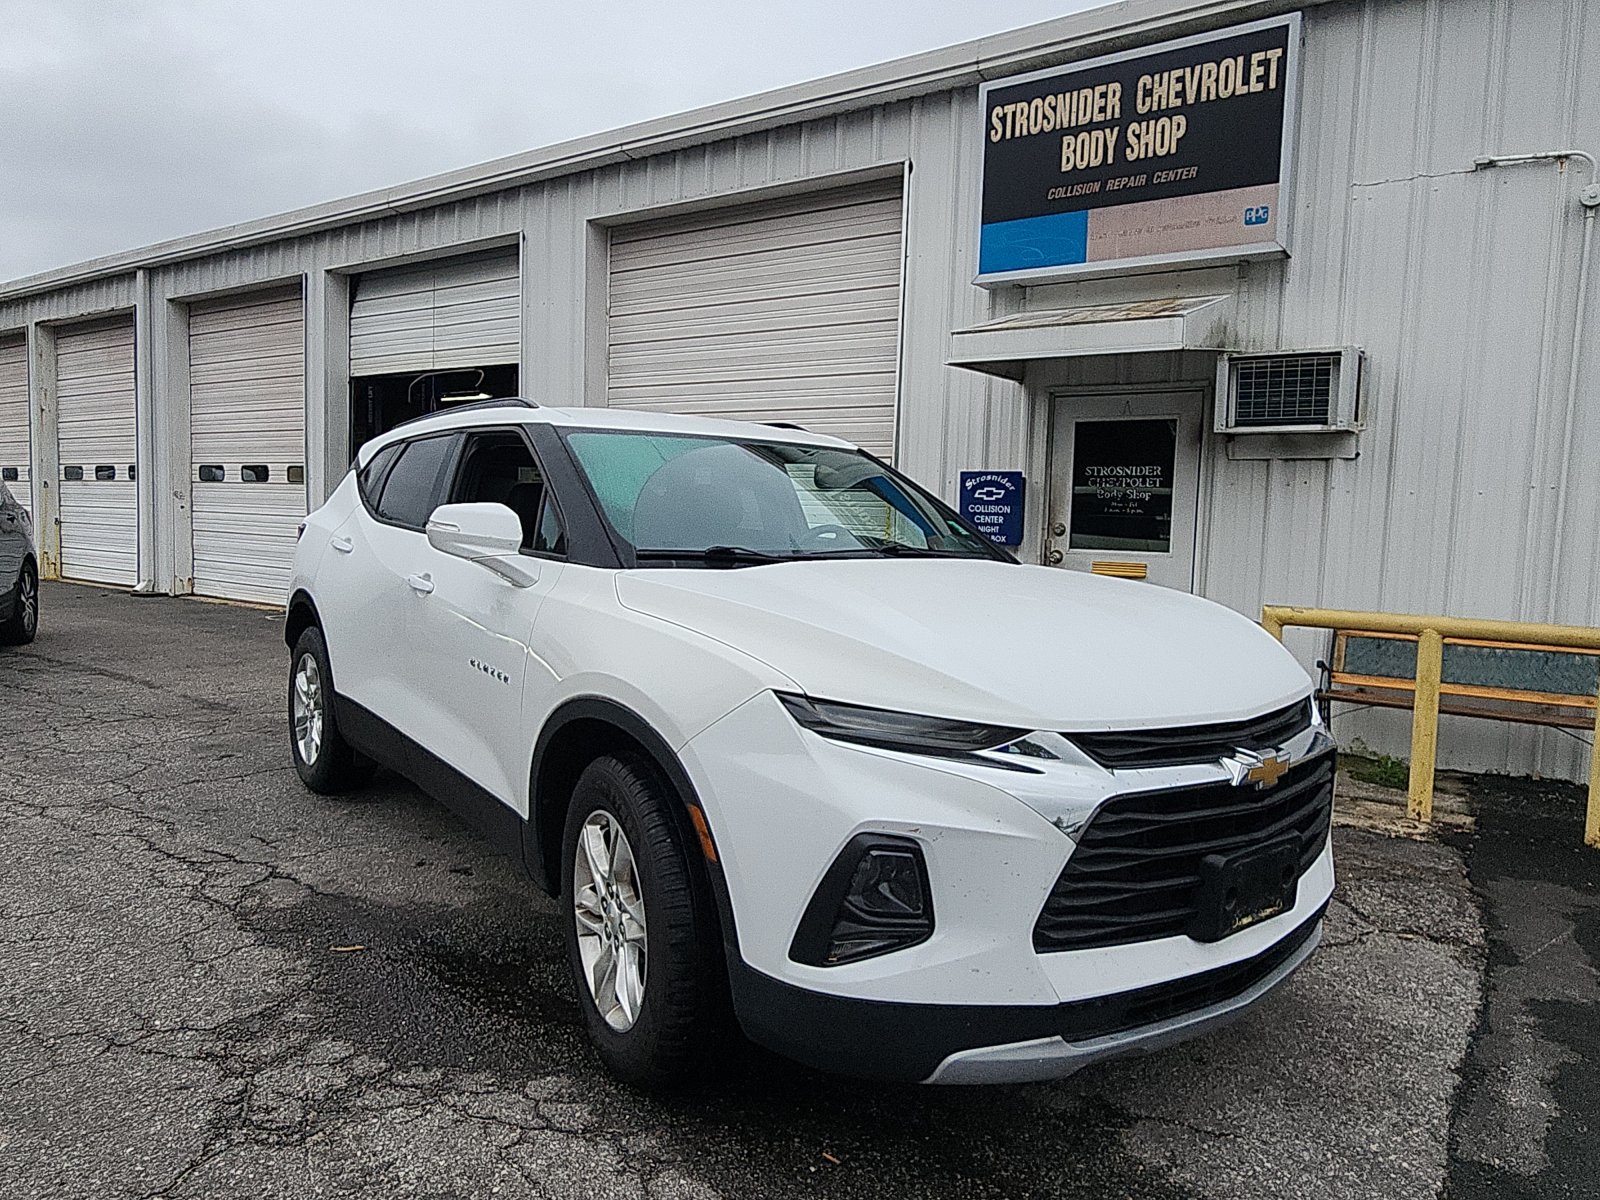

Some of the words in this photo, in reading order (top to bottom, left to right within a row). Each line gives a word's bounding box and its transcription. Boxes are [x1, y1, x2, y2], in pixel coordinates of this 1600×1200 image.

[990, 81, 1122, 143] STROSNIDER
[1136, 48, 1283, 115] CHEVROLET
[1060, 127, 1119, 172] BODY
[1125, 115, 1187, 162] SHOP
[1047, 181, 1101, 200] COLLISION
[1106, 174, 1147, 191] REPAIR
[1153, 166, 1198, 183] CENTER
[1245, 207, 1269, 223] PPG
[1085, 465, 1162, 476] STROSNIDER
[965, 474, 1016, 490] Strosnider
[968, 504, 1011, 513] COLLISION
[974, 515, 1004, 524] CENTER
[978, 525, 999, 533] NIGHT
